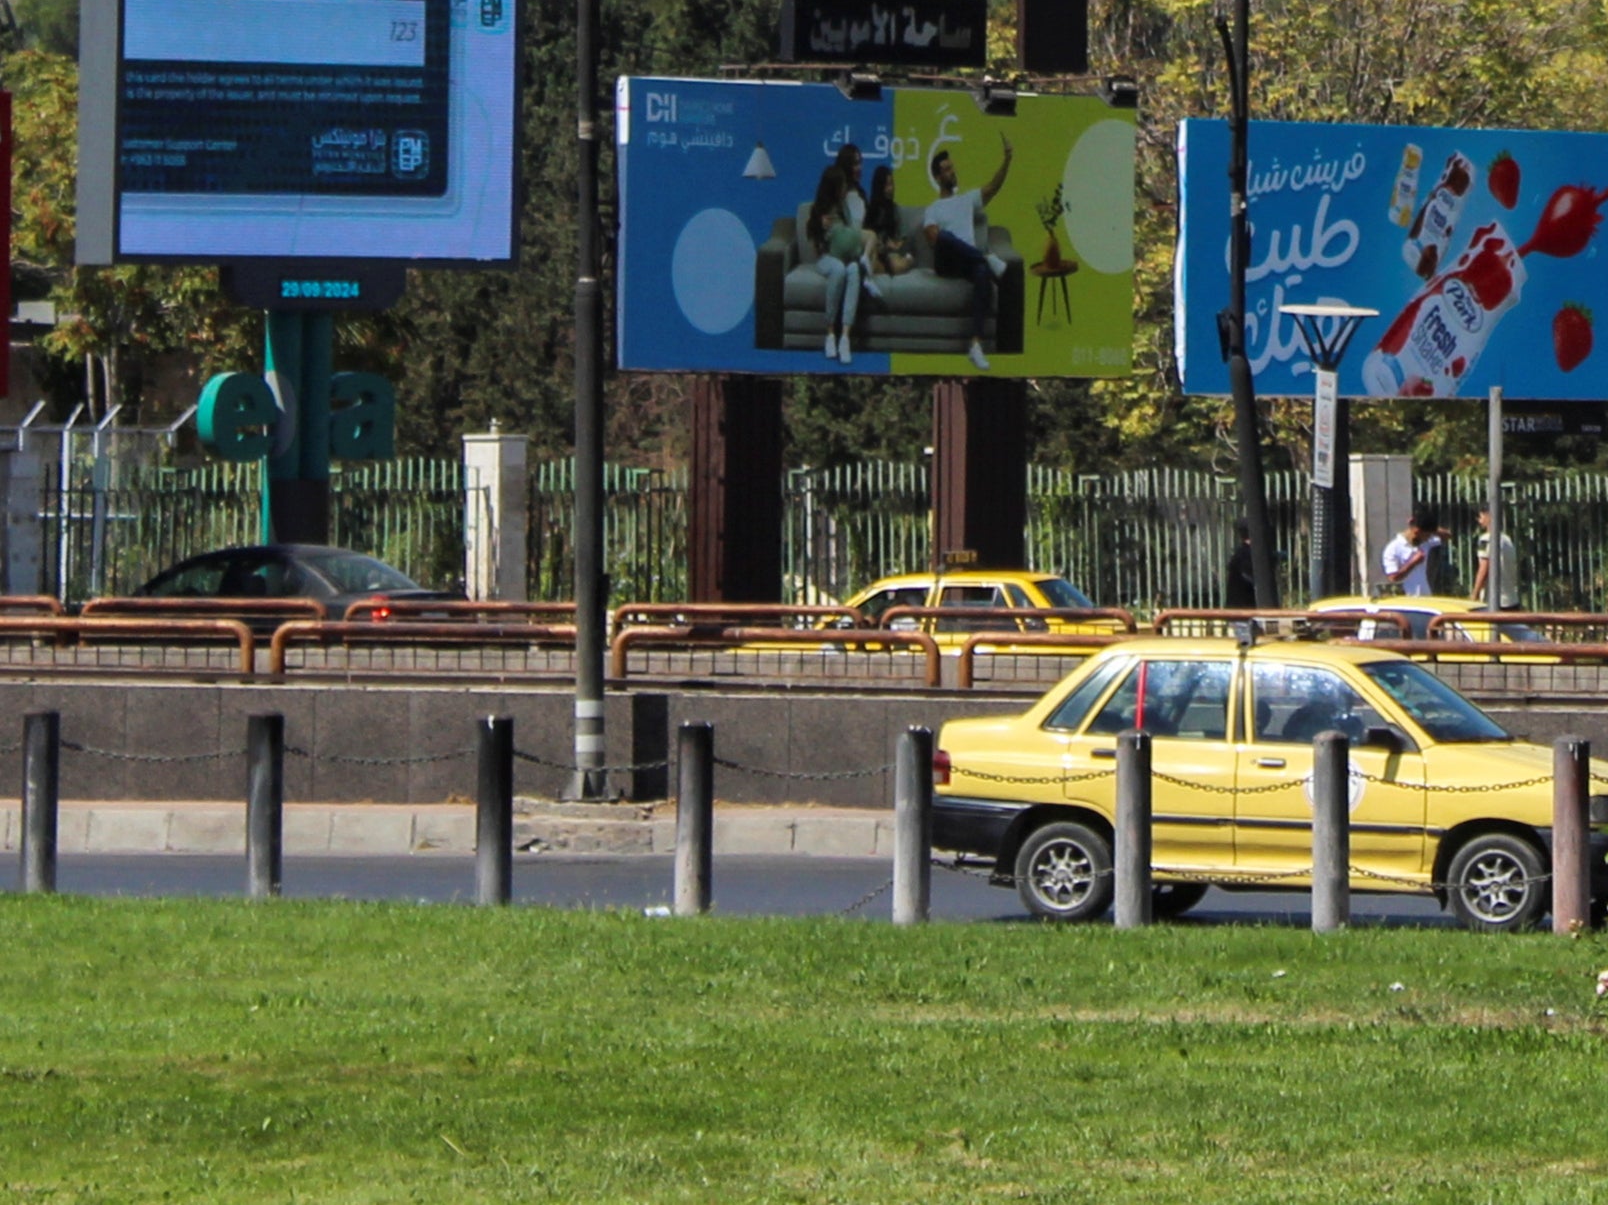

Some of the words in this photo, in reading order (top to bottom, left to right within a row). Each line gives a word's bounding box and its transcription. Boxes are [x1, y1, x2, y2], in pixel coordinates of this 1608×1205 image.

[390, 21, 418, 42] 123
[904, 6, 971, 48] ساحة
[1423, 304, 1457, 359] Fresh
